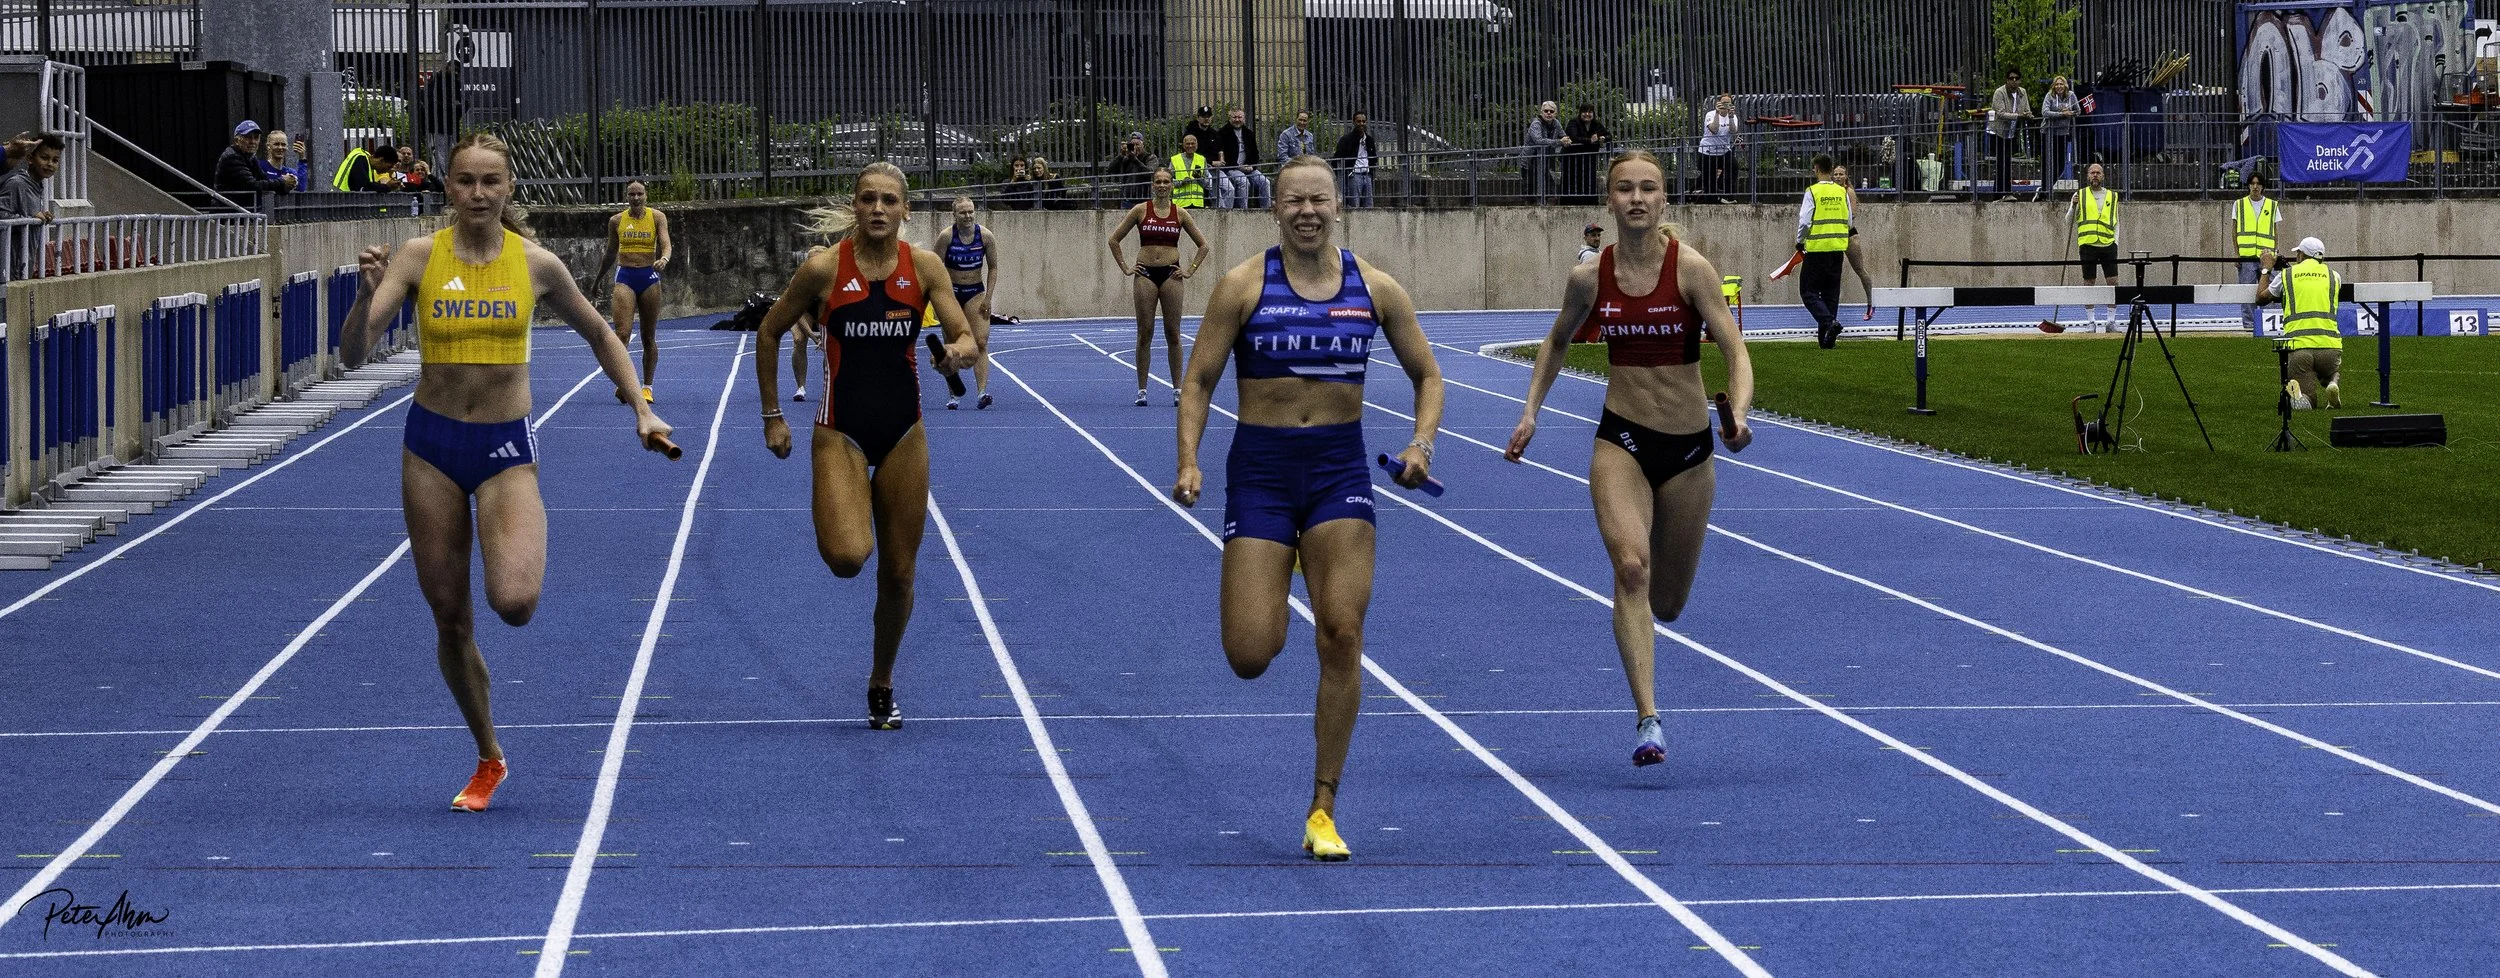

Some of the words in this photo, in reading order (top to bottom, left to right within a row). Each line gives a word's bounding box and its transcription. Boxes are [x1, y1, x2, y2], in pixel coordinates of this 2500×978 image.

[2316, 145, 2349, 157] Dansk
[2306, 159, 2343, 171] Atletik
[1142, 225, 1179, 233] DENMARK
[432, 299, 517, 319] SWEDEN
[1259, 306, 1299, 316] CRAFT
[844, 321, 912, 337] NORWAY
[1601, 323, 1684, 336] DENMARK
[2454, 316, 2478, 332] 13
[1620, 431, 1638, 453] DEN
